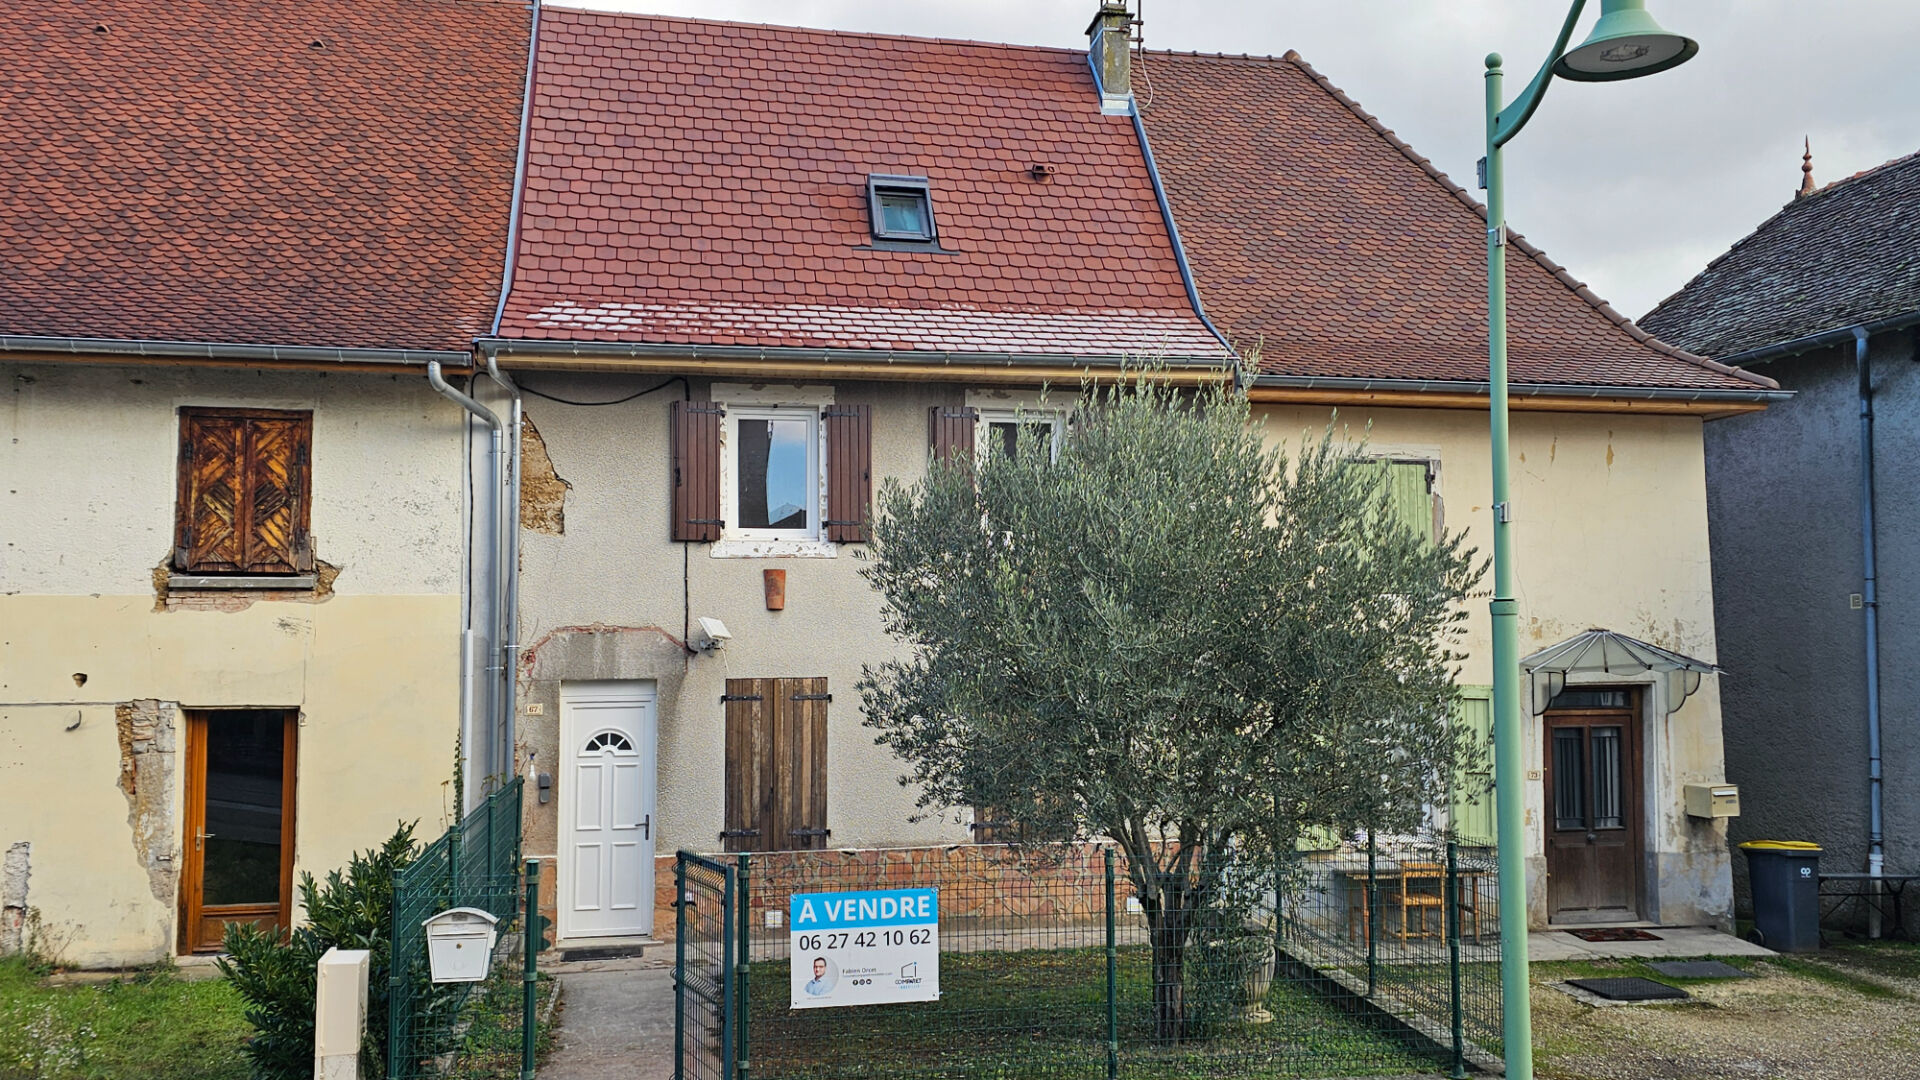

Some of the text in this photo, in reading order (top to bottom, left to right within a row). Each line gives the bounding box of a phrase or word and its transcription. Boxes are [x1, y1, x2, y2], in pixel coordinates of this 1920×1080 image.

[824, 895, 931, 922] VENDRE
[799, 928, 931, 951] 06 27 42 10 62
